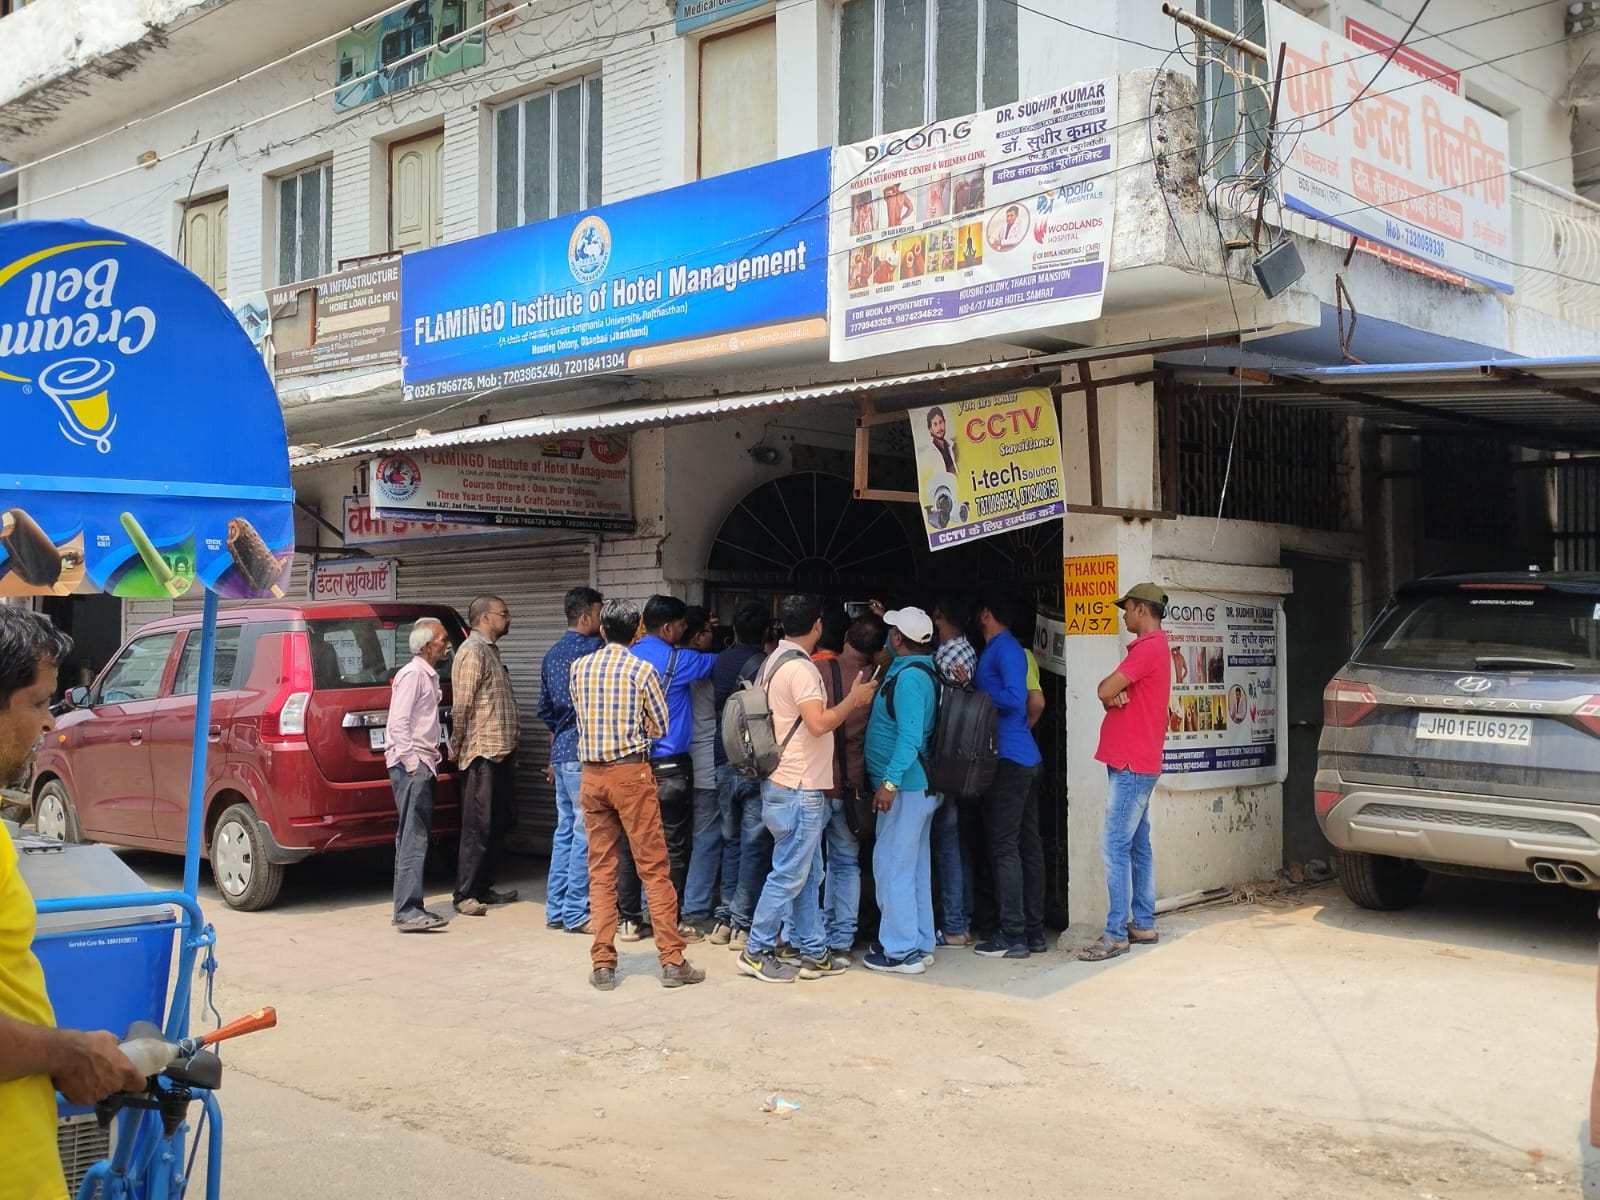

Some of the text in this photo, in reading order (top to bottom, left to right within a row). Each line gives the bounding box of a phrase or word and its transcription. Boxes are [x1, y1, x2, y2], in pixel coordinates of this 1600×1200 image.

[683, 0, 716, 18] Medical
[996, 83, 1106, 124] DR. SUDHIR KUMAR
[1026, 127, 1062, 152] सुधीर
[1065, 119, 1108, 142] कुमार
[909, 164, 932, 177] CENTRE
[967, 149, 987, 161] CLINIC
[1058, 181, 1094, 203] Apollo
[1048, 217, 1103, 234] WOODLANDS
[1385, 219, 1401, 241] Mob
[25, 258, 119, 317] Bell
[329, 267, 399, 294] INFRASTRUCTURE
[1011, 275, 1037, 290] THAKUR
[1037, 271, 1071, 286] MANSION
[414, 240, 807, 346] FLAMINGO Institute of Hotel Management
[986, 297, 1004, 311] NEAR
[1004, 293, 1025, 308] HOTEL
[1025, 287, 1055, 303] SAMRAT
[329, 300, 348, 313] HOME
[348, 297, 367, 309] LOAN
[852, 309, 864, 320] FOR
[865, 307, 883, 319] BOOK
[884, 297, 935, 316] APPOINTMENT
[0, 306, 156, 357] Cream
[414, 383, 435, 399] 0326
[436, 377, 476, 395] 7966726,
[477, 373, 497, 389] Mob
[564, 352, 625, 375] 7201841304
[965, 403, 1042, 444] CCTV
[999, 435, 1055, 456] Surveillance
[423, 450, 484, 468] FLAMINGO
[487, 456, 528, 473] Institute
[531, 461, 542, 473] of
[543, 462, 568, 475] Hotel
[571, 463, 627, 481] Management
[462, 478, 495, 490] Courses
[496, 481, 526, 493] Offered
[532, 483, 547, 493] One
[549, 484, 565, 495] Year
[436, 489, 460, 501] Three
[462, 491, 484, 502] Years
[486, 492, 514, 505] Degree
[524, 495, 544, 506] Craft
[545, 496, 572, 507] Course
[938, 528, 966, 544] CCTV
[968, 523, 980, 536] के
[982, 519, 1004, 533] लिए
[1065, 560, 1116, 577] THAKUR
[1065, 580, 1116, 597] MANSION
[1074, 602, 1110, 616] MIG-
[1225, 606, 1234, 618] DR.
[1235, 606, 1254, 619] SUDHIR
[1068, 618, 1112, 632] A/37
[1241, 631, 1257, 648] सुधीर
[1403, 695, 1543, 711] ALCAZAR
[1427, 718, 1529, 741] JH01EU6922
